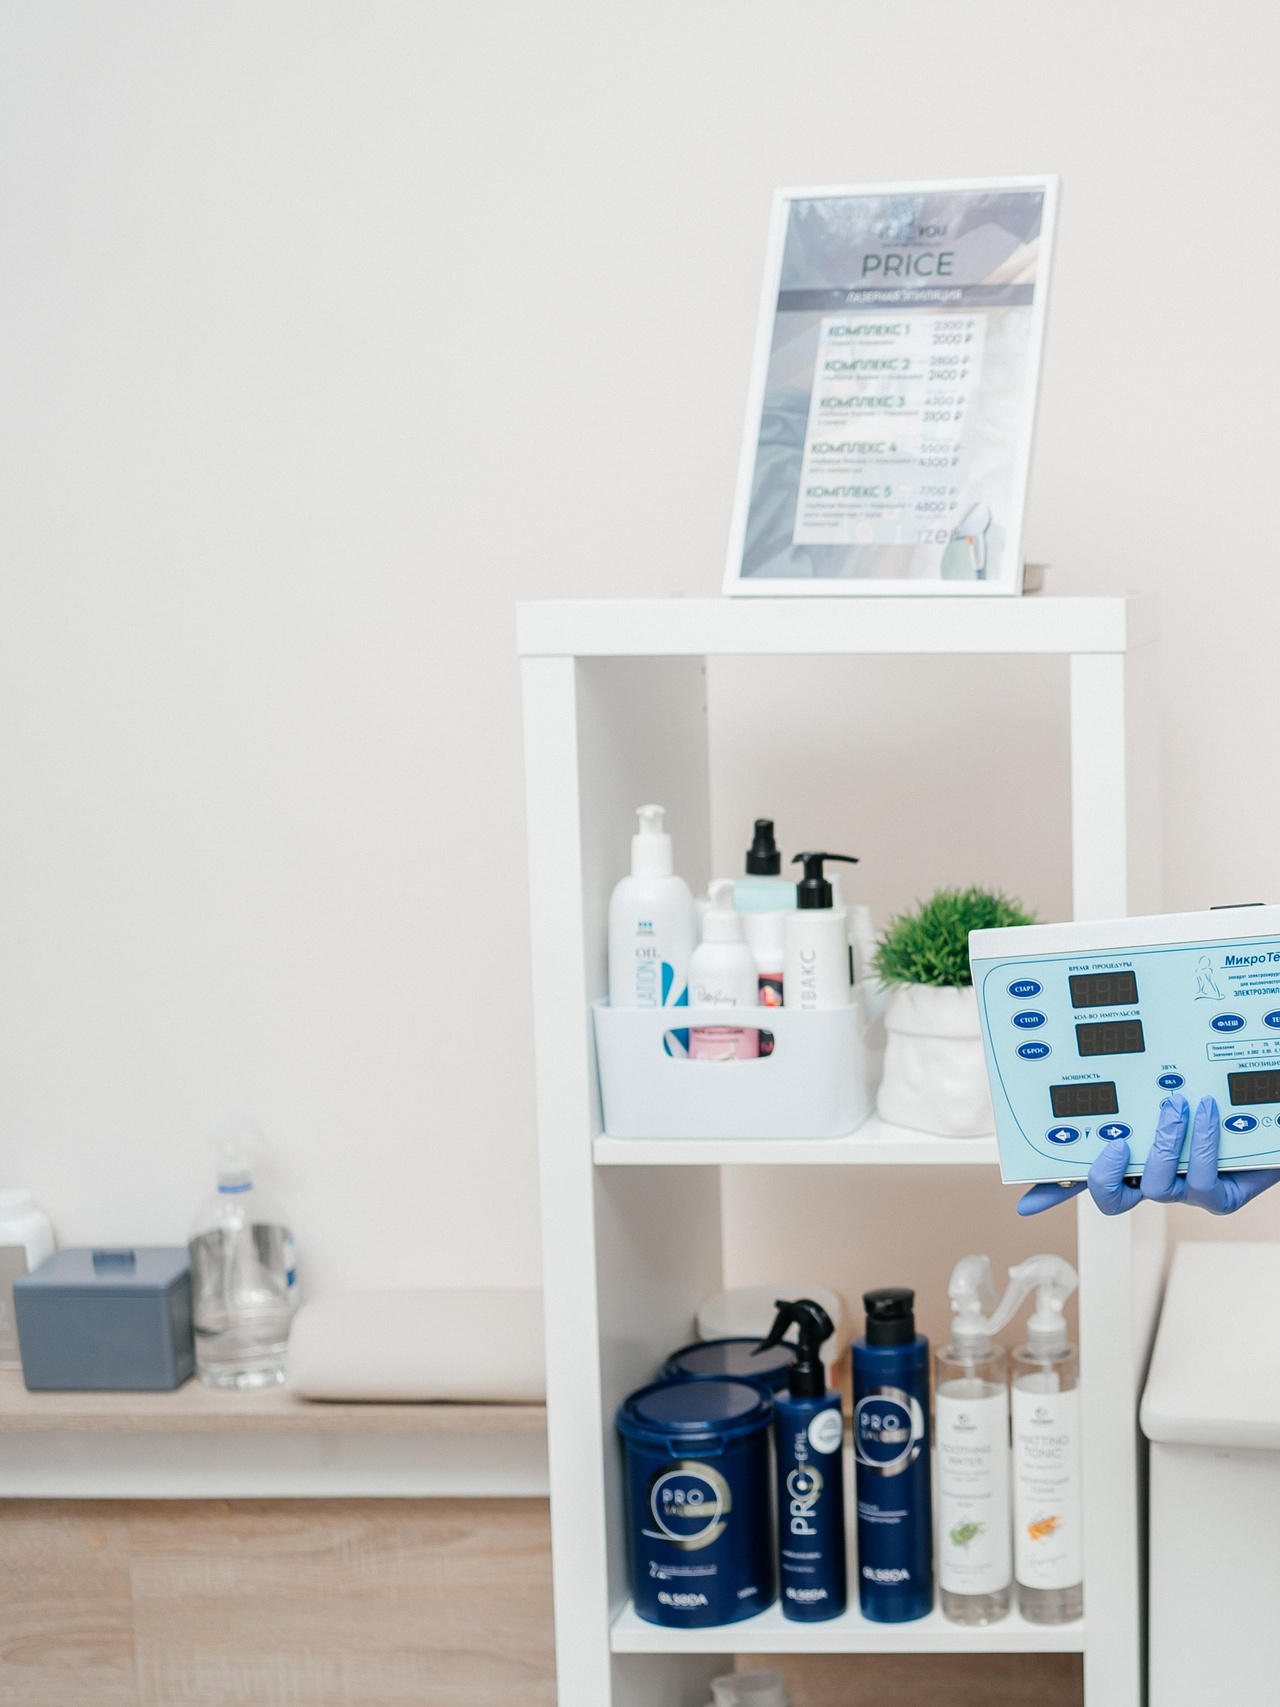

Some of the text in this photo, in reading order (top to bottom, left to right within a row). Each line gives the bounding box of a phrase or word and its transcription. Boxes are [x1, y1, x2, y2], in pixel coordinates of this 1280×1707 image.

[861, 251, 956, 278] PRICE
[828, 323, 910, 337] КОМПЛЕКС 1
[931, 333, 962, 345] 2000
[824, 358, 911, 371] КОМПЛЕКС 2
[820, 395, 905, 409] КОМПЛЕКС 3
[811, 441, 897, 454] КОМПЛЕКС 4
[805, 485, 892, 498] КОМПЛЕКС 5
[1068, 961, 1133, 972] ВРЕМЯ ПРОЦЕДУРЫ
[1014, 985, 1035, 993] СТАРТ
[1019, 1016, 1039, 1024] СТОП
[1074, 1010, 1141, 1021] КОЛ-ВО ИМПУЛЬСОВ
[1217, 1019, 1239, 1027] ФЛЕШ
[1022, 1047, 1045, 1055] СБРОС
[1061, 1072, 1101, 1081] МОЩНОСТЬ
[860, 1412, 900, 1432] PRO
[662, 1488, 705, 1506] PRO
